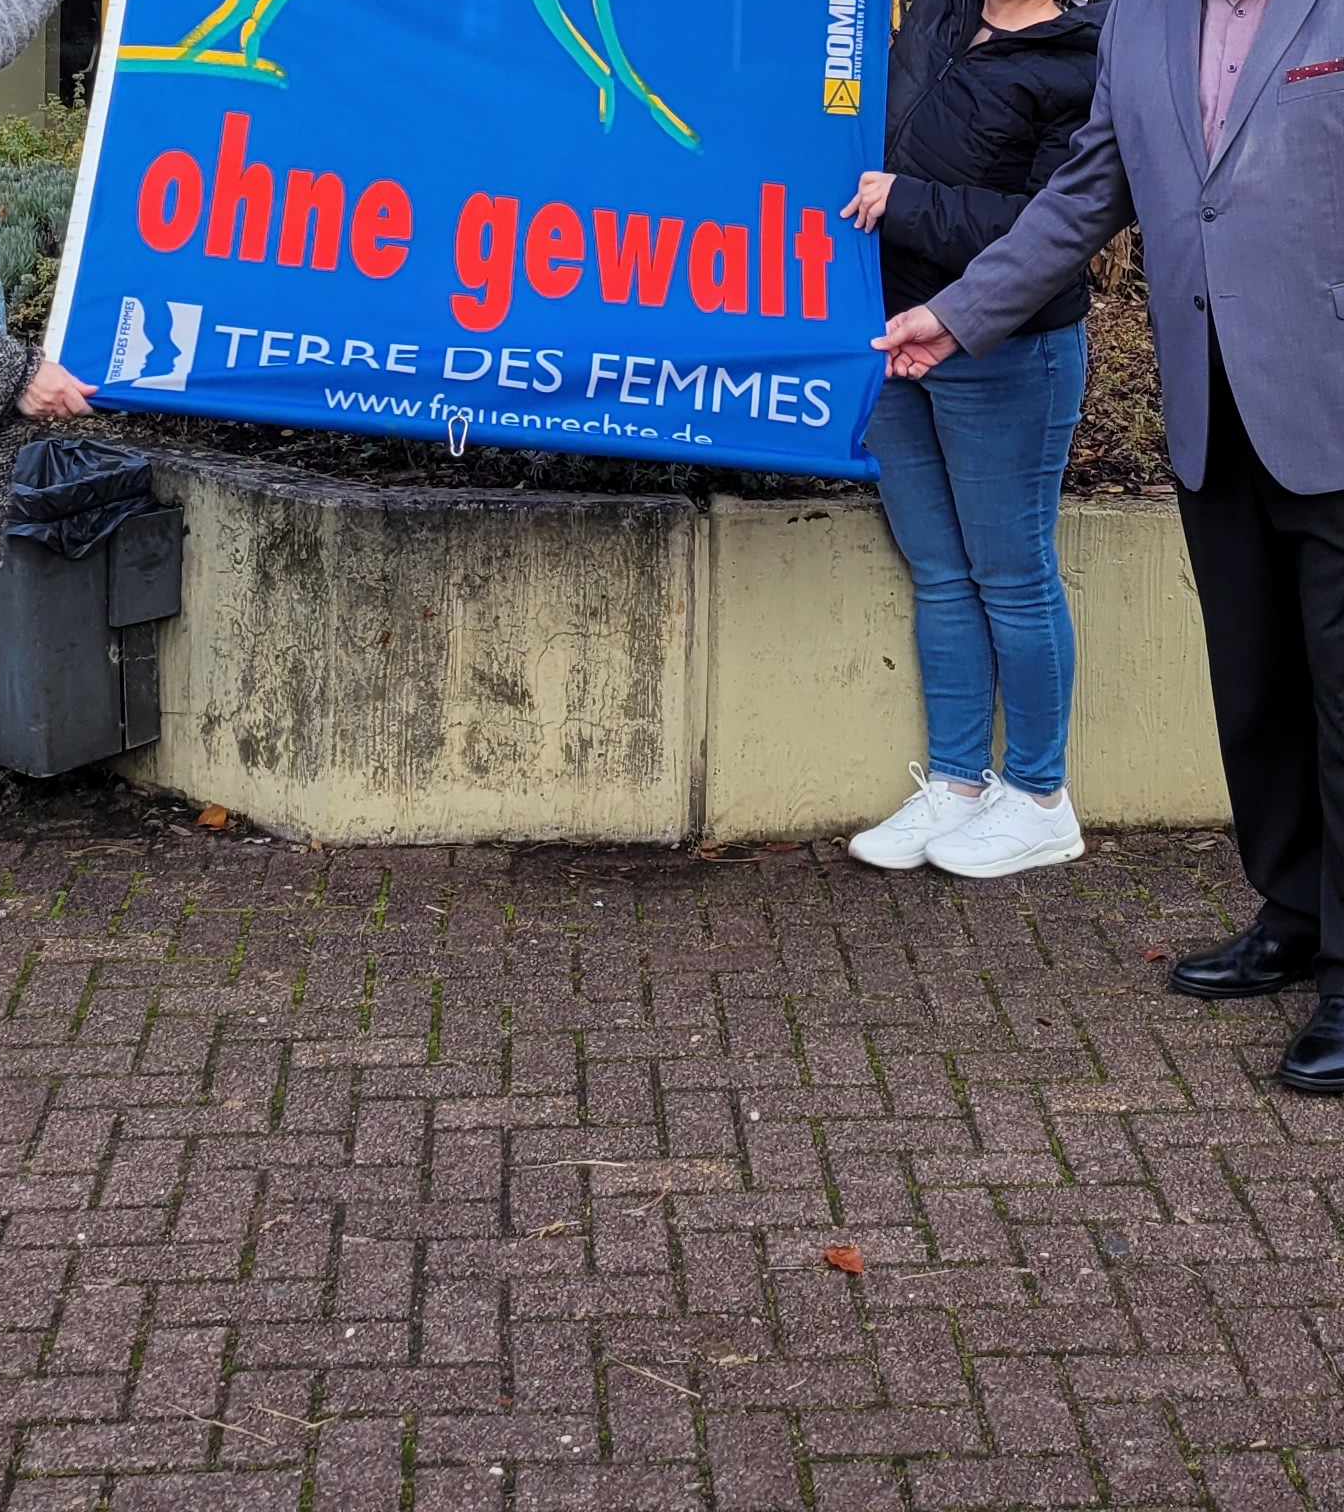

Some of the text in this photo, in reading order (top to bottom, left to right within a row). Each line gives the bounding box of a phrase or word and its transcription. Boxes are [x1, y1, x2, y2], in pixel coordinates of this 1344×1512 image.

[853, 11, 865, 80] STUTTGARTER
[136, 110, 835, 334] ohne gewalt
[109, 300, 136, 381] TERRE DES FEMMES
[214, 324, 832, 428] TERRE DES FEMMES
[323, 386, 714, 446] www.frauenrechte.de
